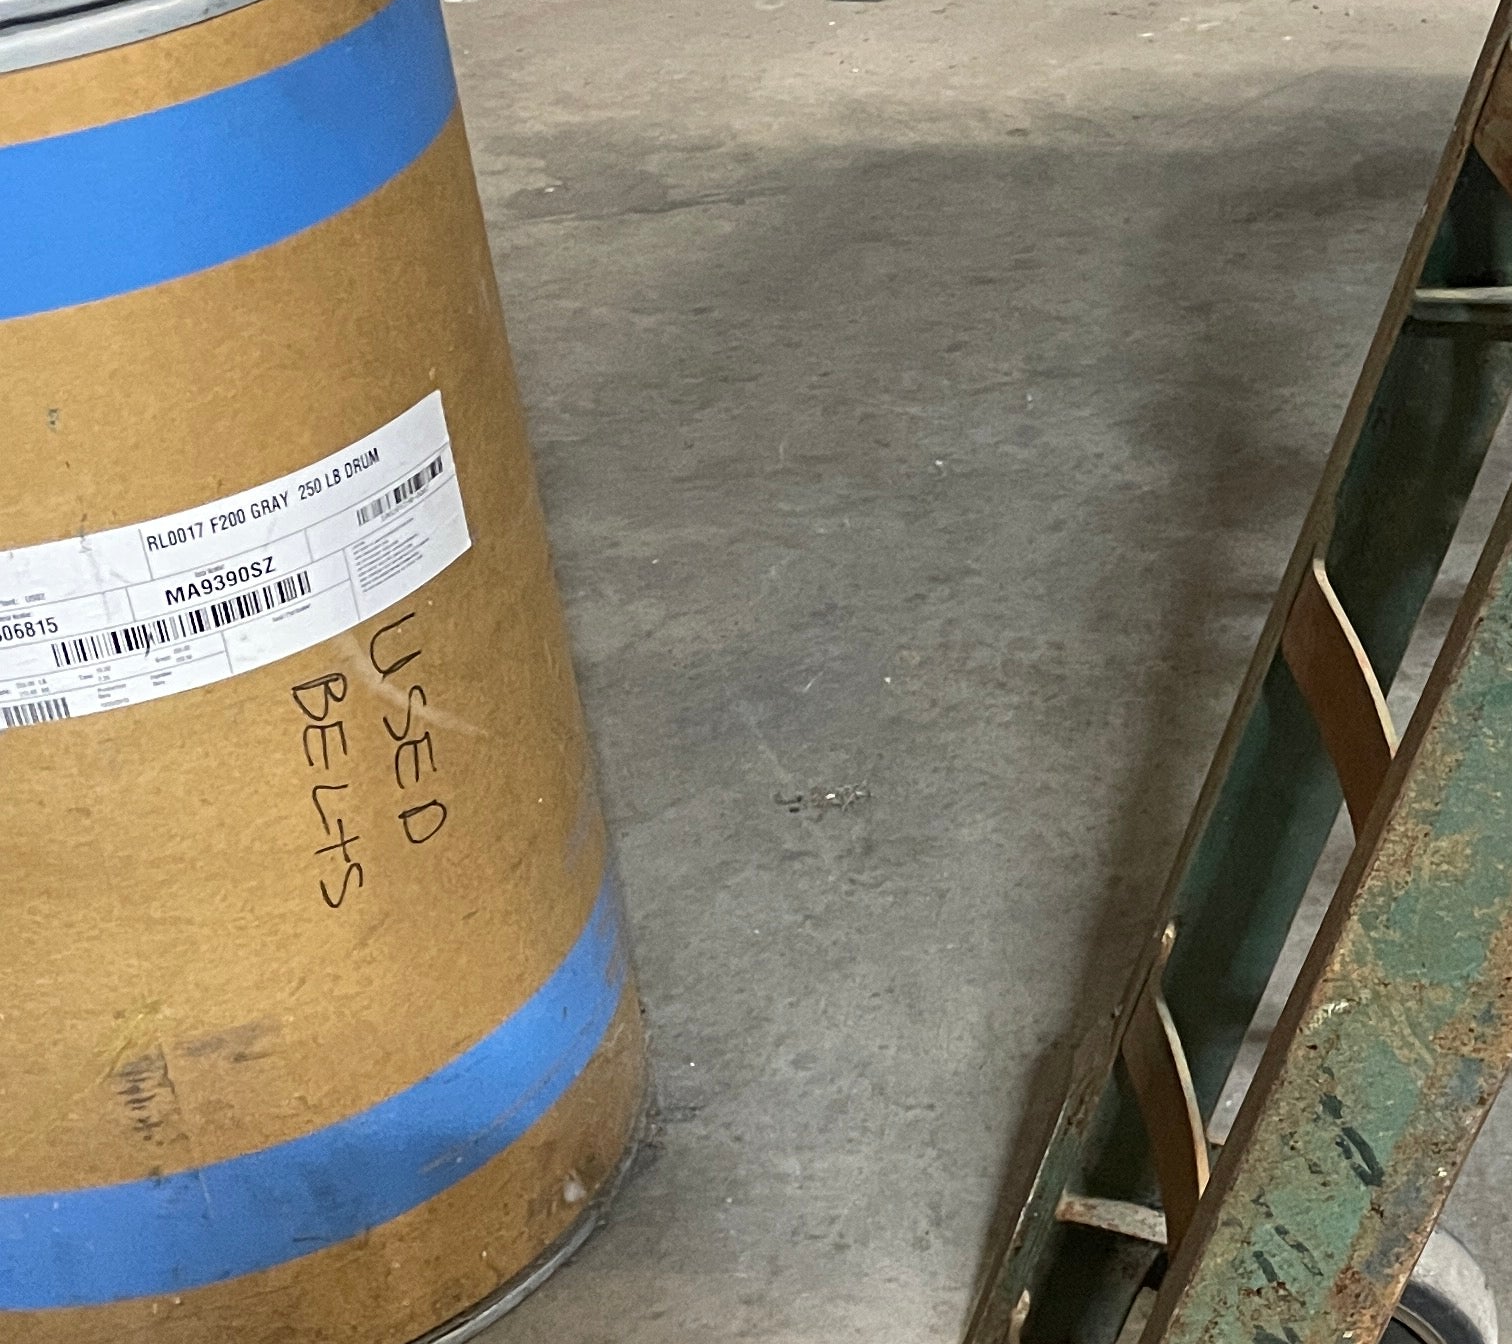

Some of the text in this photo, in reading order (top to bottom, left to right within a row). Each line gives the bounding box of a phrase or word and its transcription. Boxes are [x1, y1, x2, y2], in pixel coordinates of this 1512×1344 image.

[146, 447, 380, 552] RL0017 F200 GRAY 250 LB DRUM
[165, 556, 276, 605] MA9390SZ
[370, 612, 447, 844] USED
